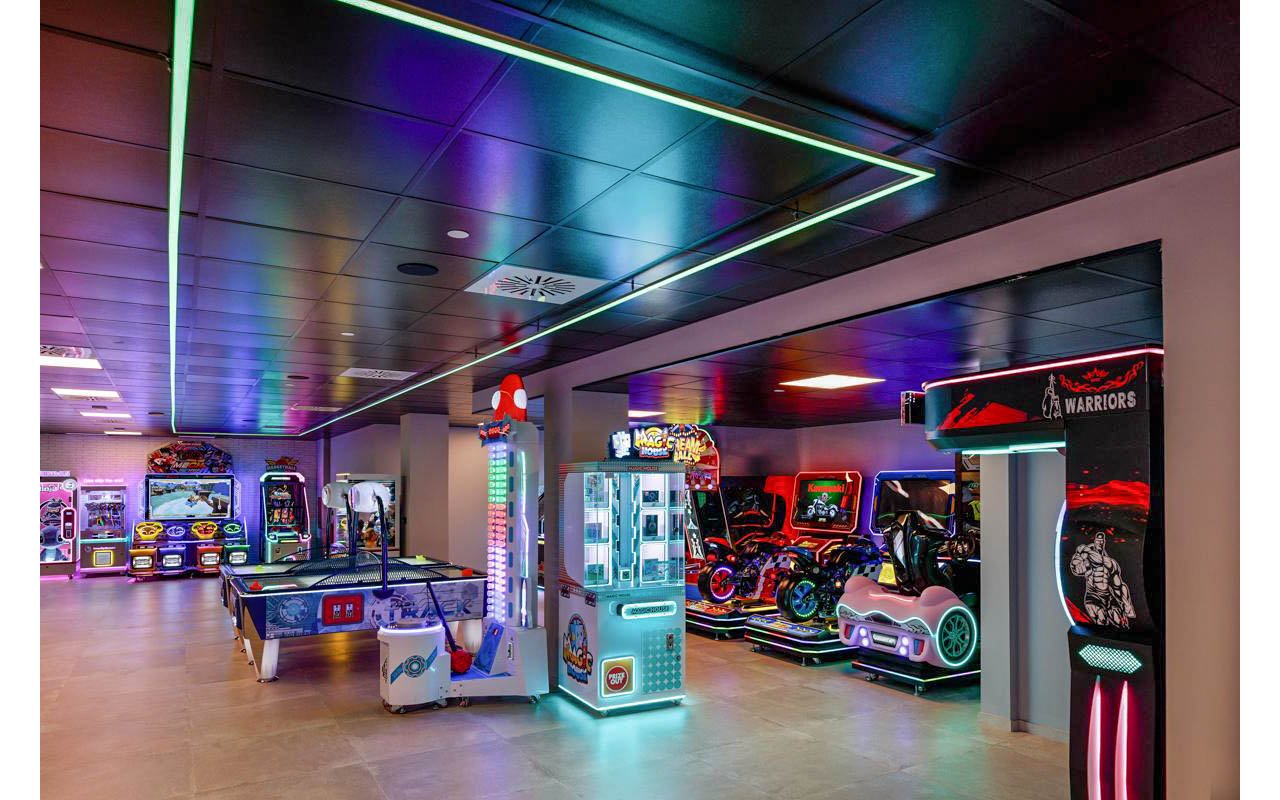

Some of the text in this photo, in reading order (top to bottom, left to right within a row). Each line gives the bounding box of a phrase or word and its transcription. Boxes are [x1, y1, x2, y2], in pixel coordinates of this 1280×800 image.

[1065, 391, 1136, 414] WARRIORS
[641, 446, 669, 456] HOUSE
[808, 484, 845, 492] Kawasaki
[608, 672, 626, 681] PRIZE
